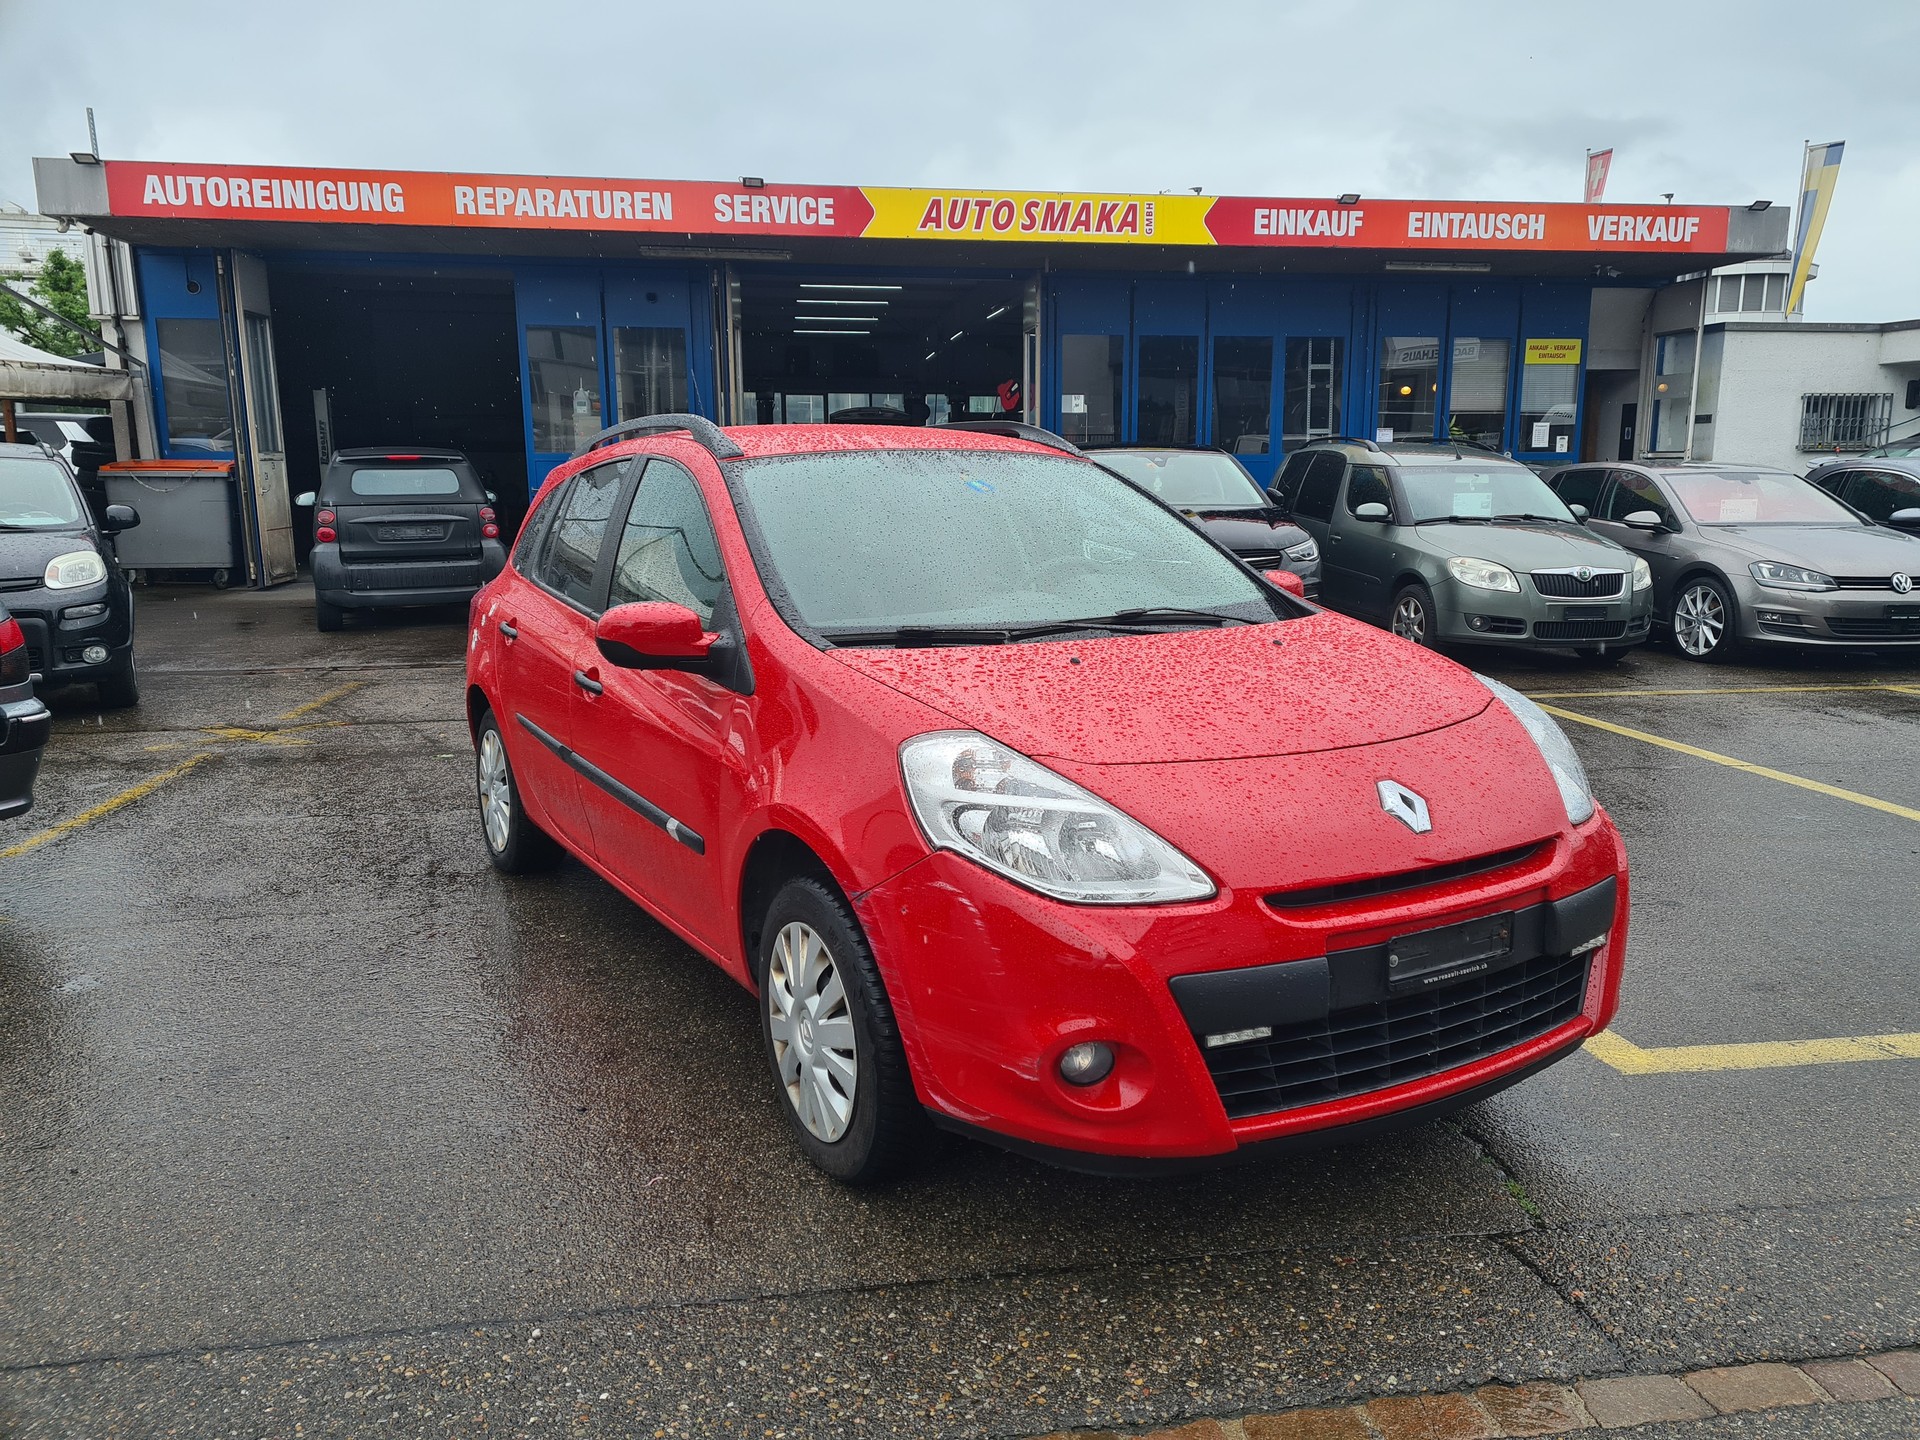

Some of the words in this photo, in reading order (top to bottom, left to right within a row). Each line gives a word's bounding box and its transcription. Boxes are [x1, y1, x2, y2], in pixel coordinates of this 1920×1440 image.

[143, 174, 404, 213] AUTOREINIGUNG
[454, 185, 673, 221] REPARATUREN
[713, 193, 835, 225] SERVICE
[918, 196, 1017, 233] AUTO
[1019, 198, 1140, 236] SMAKA
[1144, 201, 1155, 236] GMBH
[1253, 207, 1364, 238] EINKAUF
[1407, 210, 1546, 241] EINTAUSCH
[1587, 214, 1700, 243] VERKAUF
